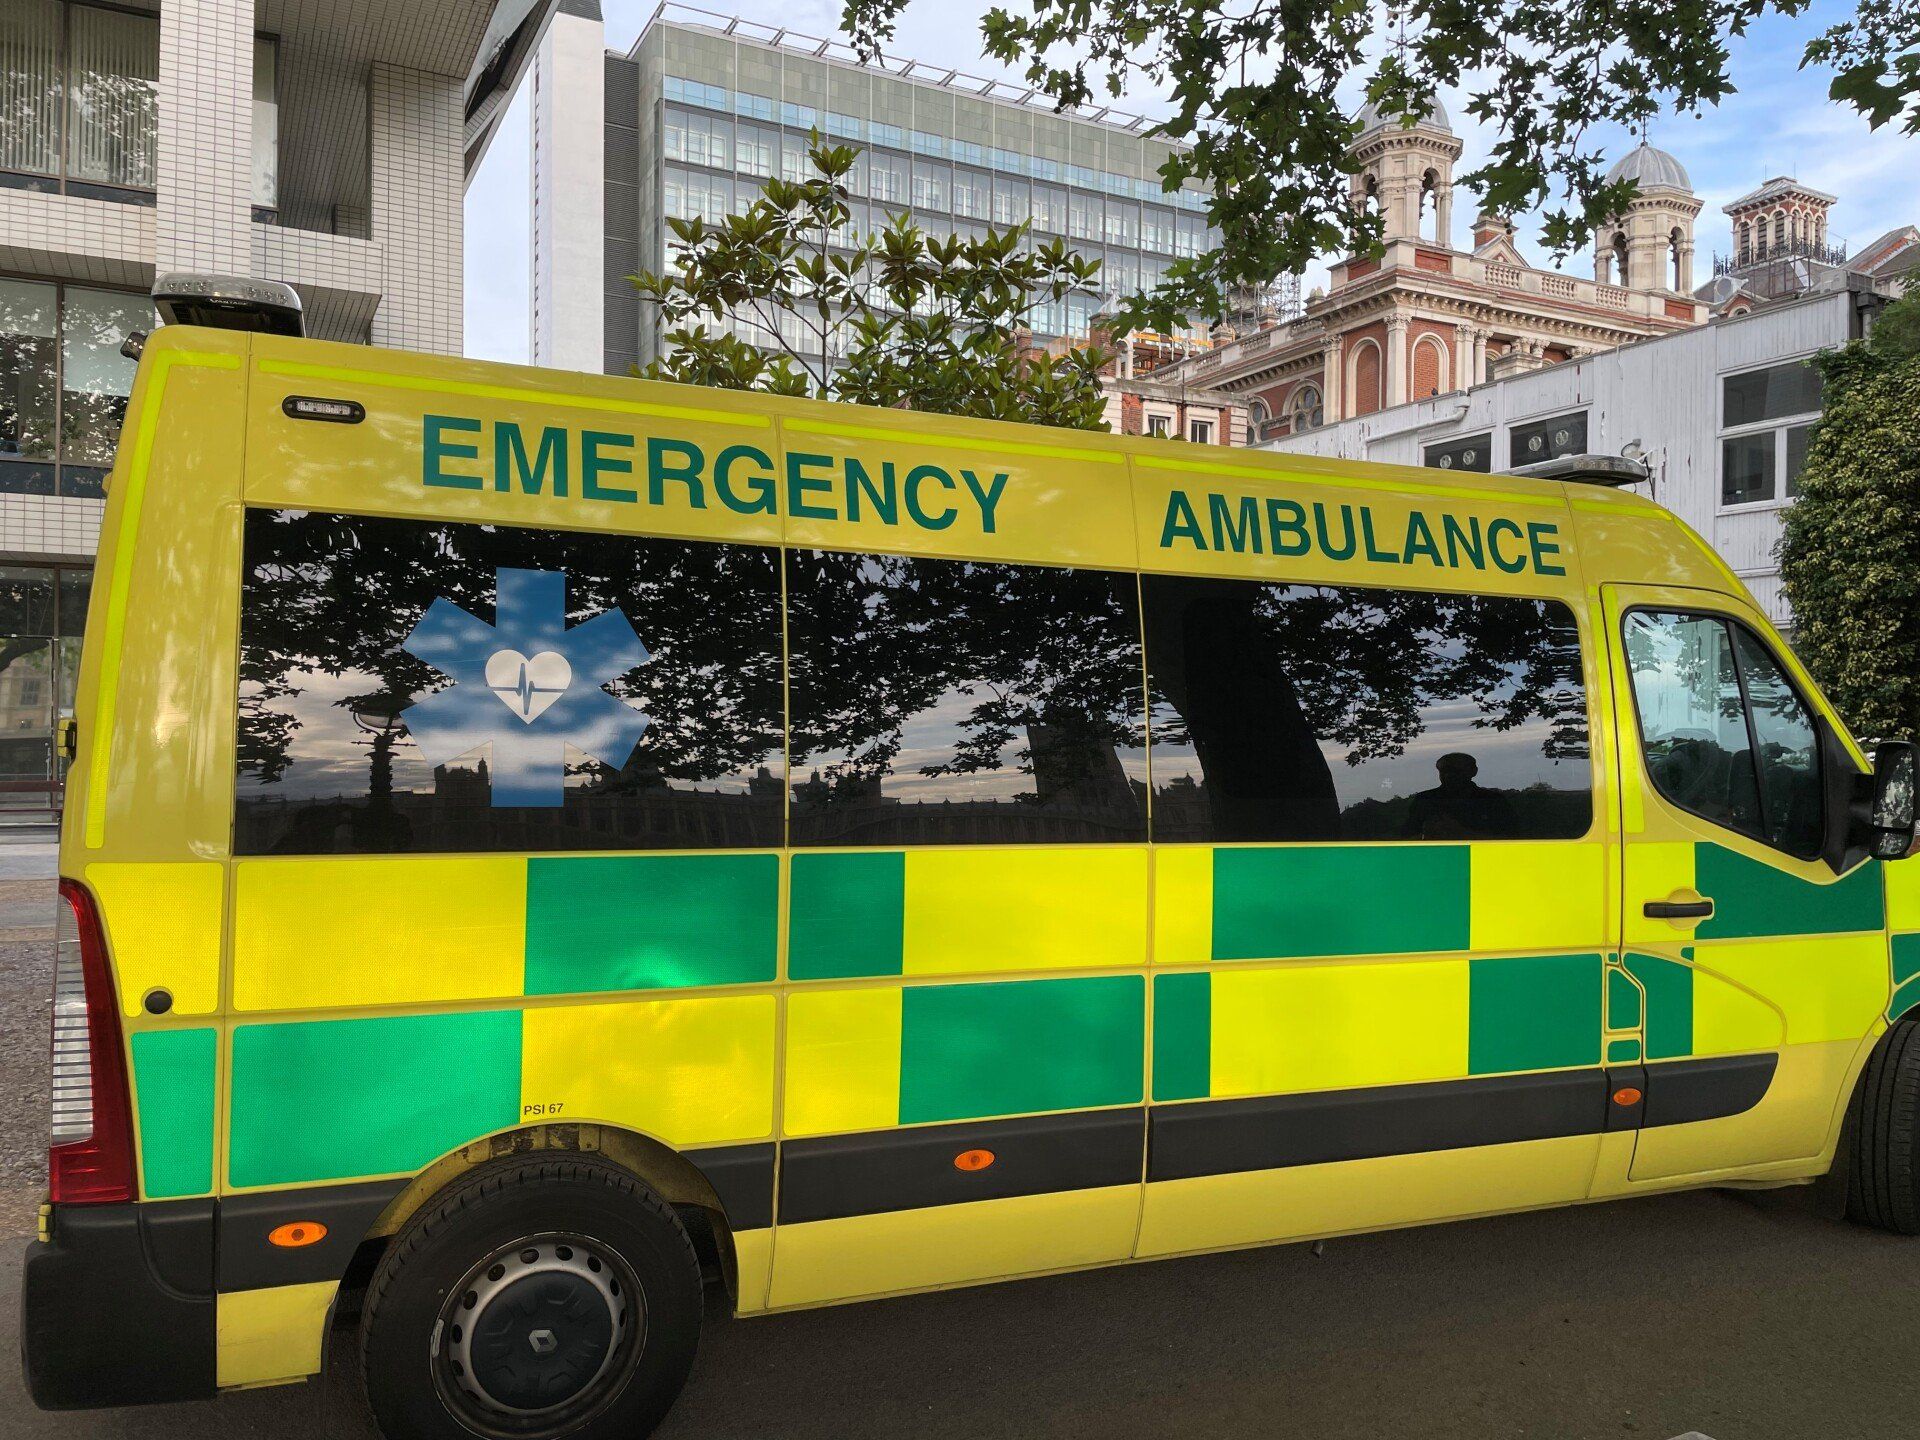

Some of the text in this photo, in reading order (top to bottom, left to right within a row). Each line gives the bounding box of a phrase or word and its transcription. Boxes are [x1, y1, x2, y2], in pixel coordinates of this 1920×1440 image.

[424, 415, 1566, 576] EMERGENCY AMBULANCE
[524, 1103, 564, 1115] PSI 67
